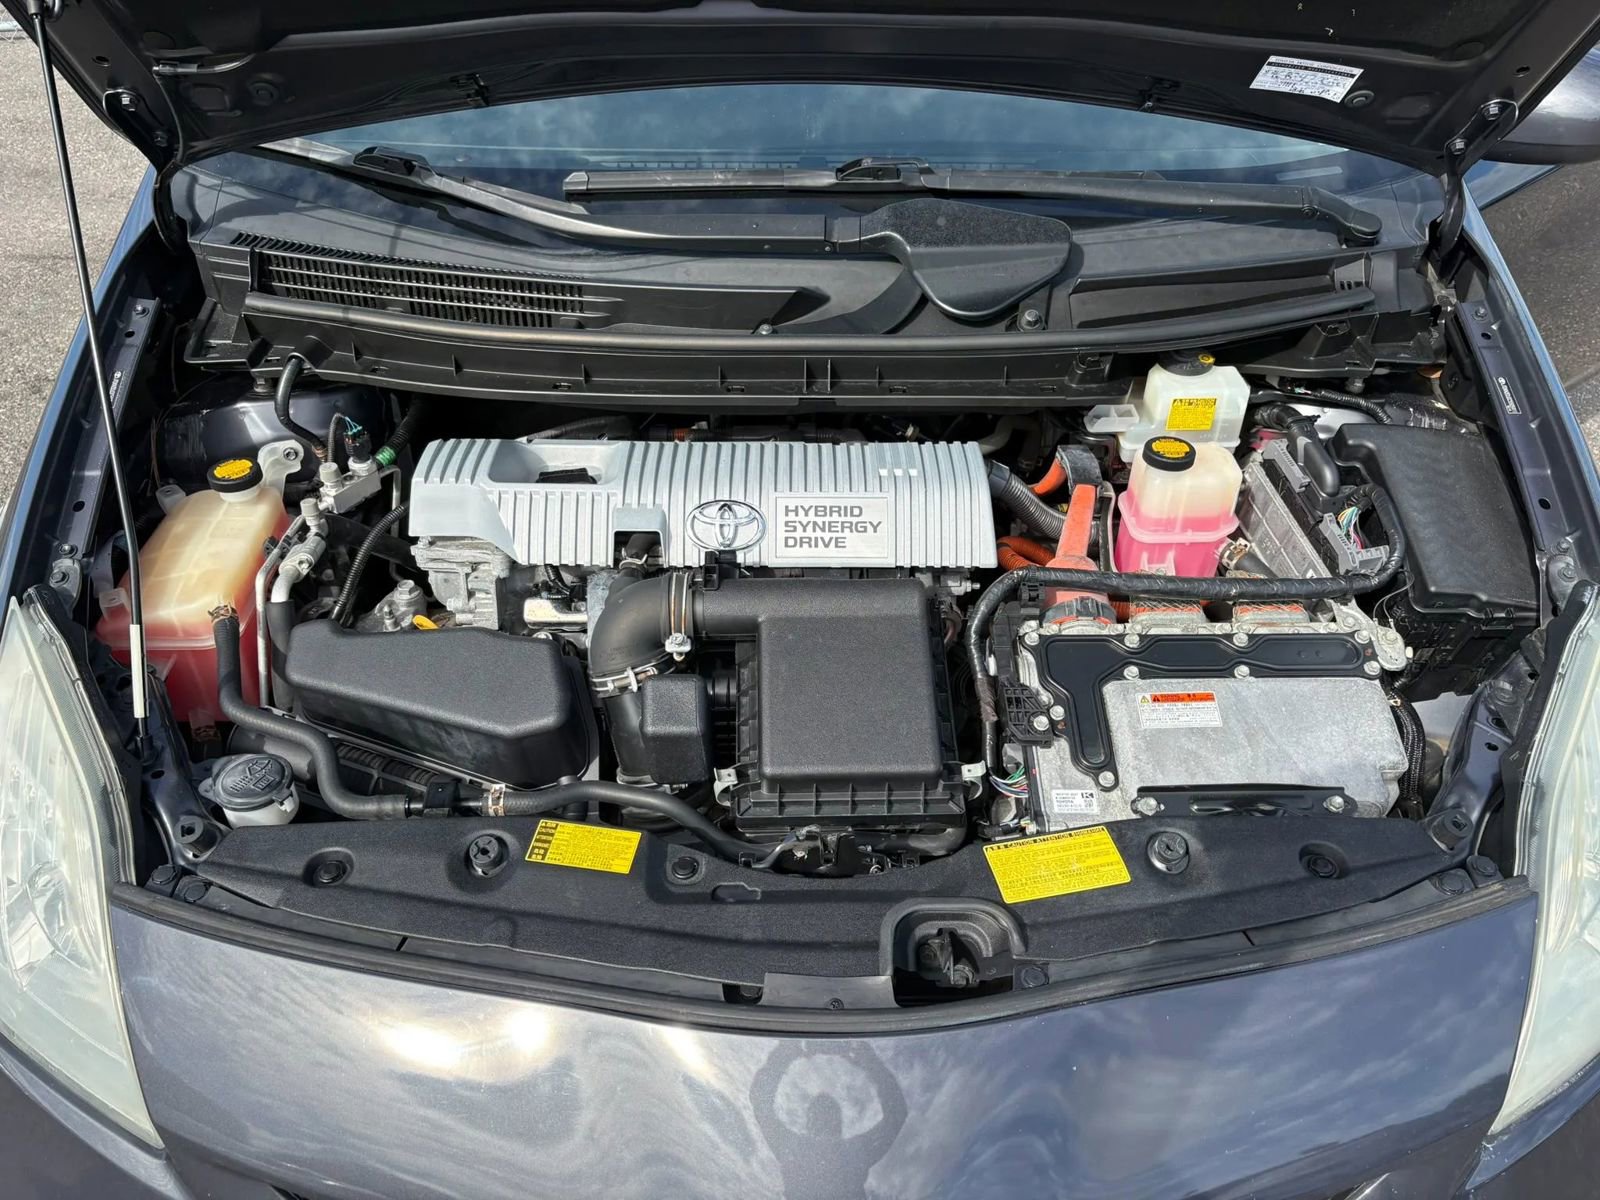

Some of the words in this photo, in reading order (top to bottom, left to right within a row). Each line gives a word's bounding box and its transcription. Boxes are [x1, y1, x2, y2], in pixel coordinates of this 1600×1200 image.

[784, 505, 863, 518] HYBRID
[784, 520, 882, 533] SYNERGY
[784, 536, 847, 548] DRIVE
